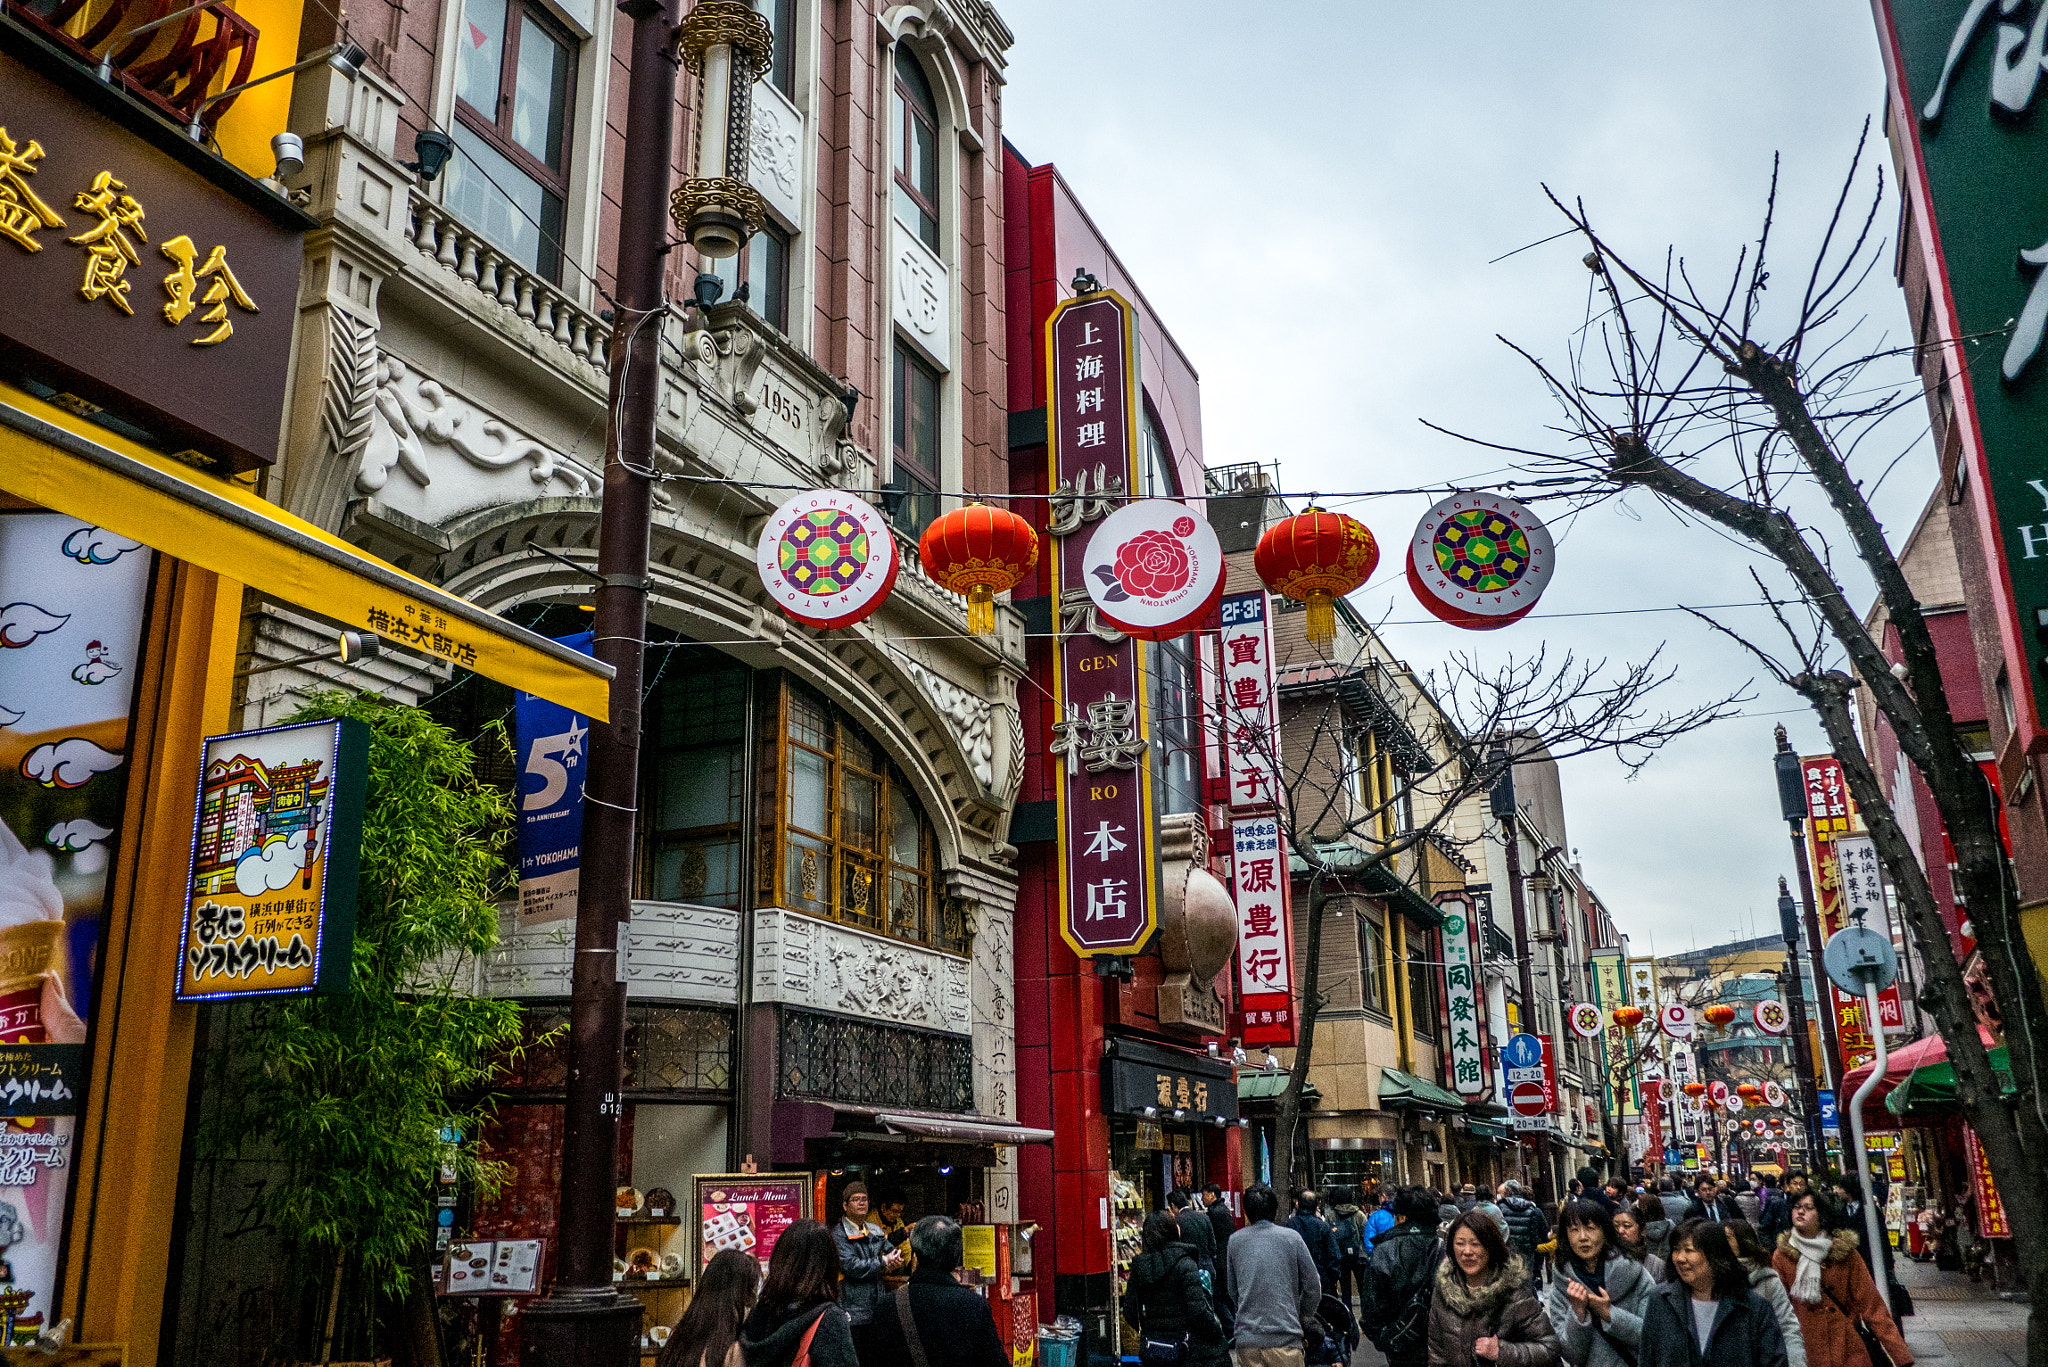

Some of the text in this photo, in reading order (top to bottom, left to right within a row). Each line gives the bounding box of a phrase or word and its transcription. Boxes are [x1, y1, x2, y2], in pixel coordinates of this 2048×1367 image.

[1075, 322, 1106, 449] 上海料理
[762, 384, 801, 430] 1955
[767, 499, 881, 608] YOKOHAMA CHINATOWN
[1421, 499, 1543, 605] YOKOHAMA CHINATOWN
[1140, 545, 1199, 607] YOKOHAMA CHINATOWN
[404, 604, 448, 631] 中華街
[1079, 654, 1119, 674] GEN
[566, 756, 578, 768] TH
[1090, 785, 1118, 801] RO
[1806, 766, 1828, 818] 食べ放題
[535, 846, 579, 865] YOKOHAMA
[1083, 820, 1127, 923] 本店
[1858, 847, 1880, 902] 横浜名物
[249, 898, 317, 918] 横浜中華街で
[253, 915, 314, 935] 行列ができる
[1480, 915, 1491, 954] DALIAN
[189, 933, 313, 981] ソフトクリーム
[1245, 1010, 1288, 1026] 貿易部
[1447, 963, 1481, 1085] 同發本館
[728, 1191, 787, 1201] Lunch Menu
